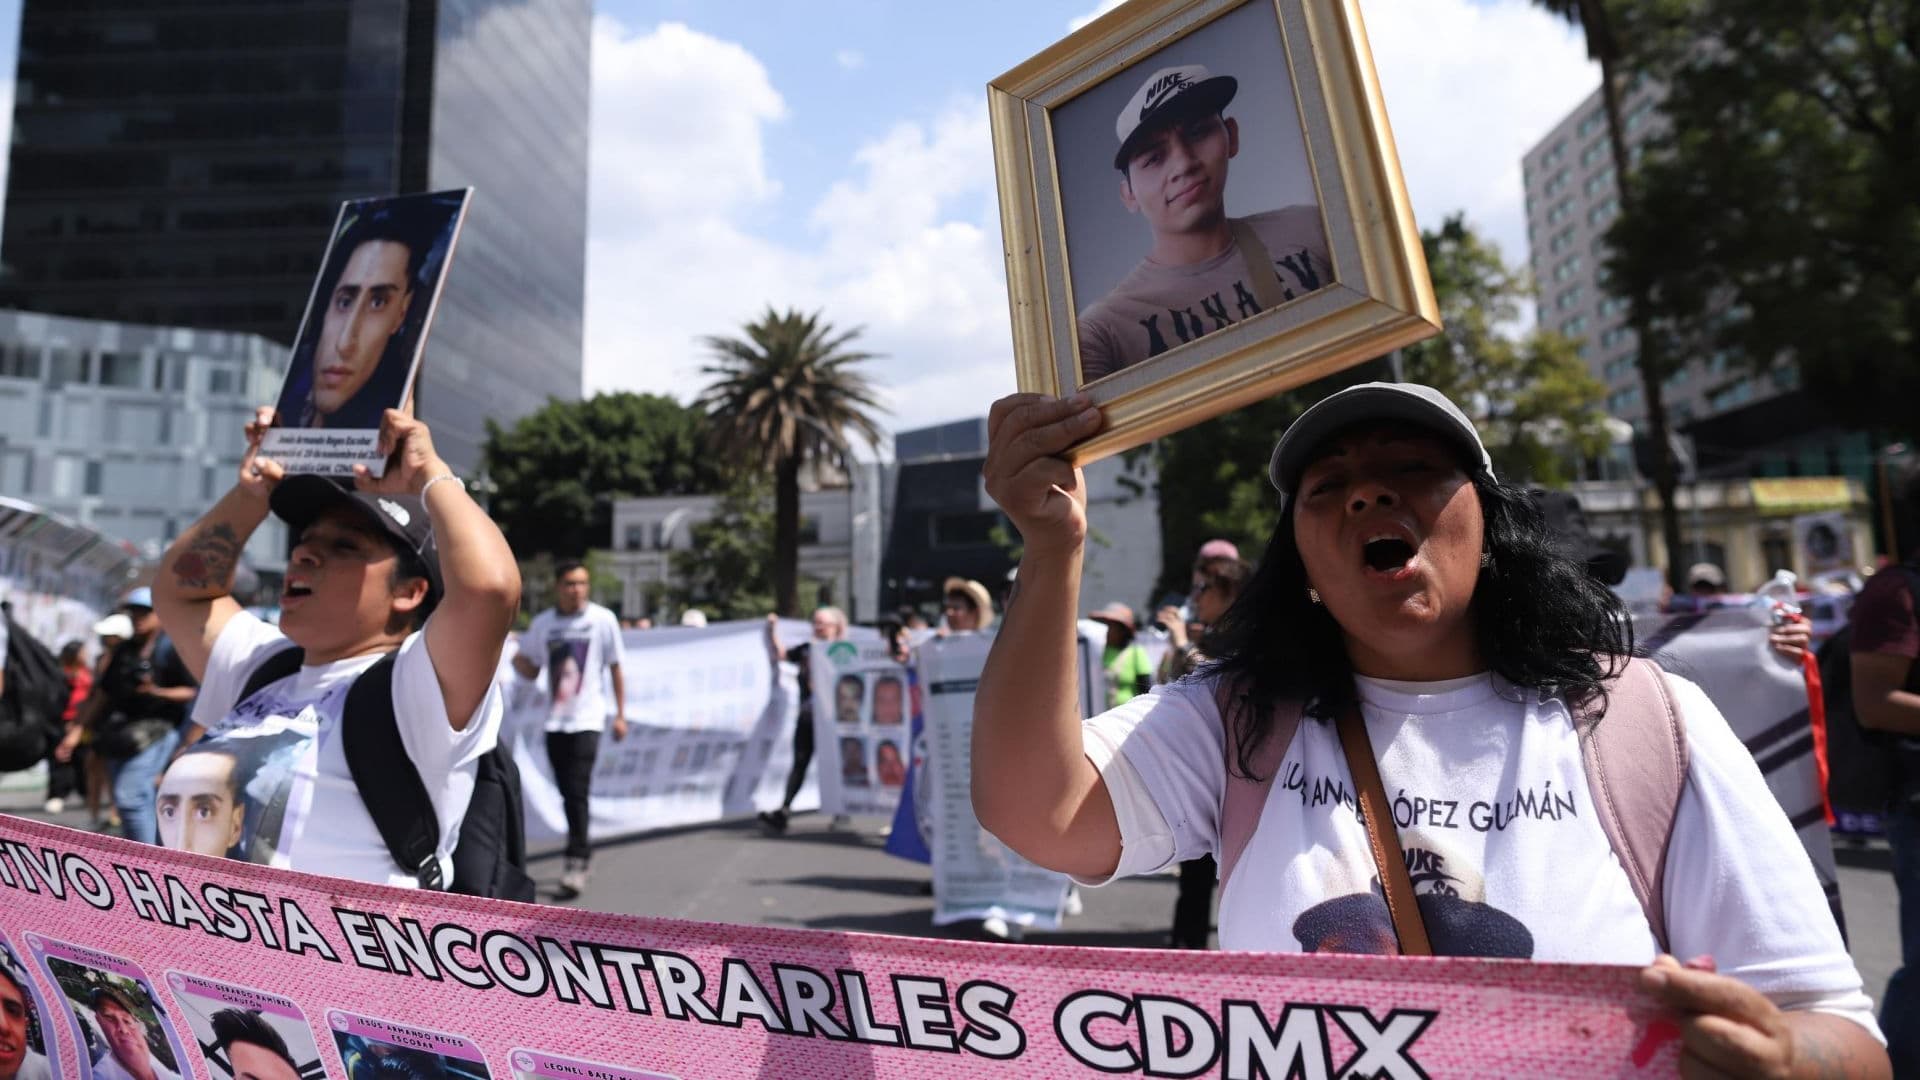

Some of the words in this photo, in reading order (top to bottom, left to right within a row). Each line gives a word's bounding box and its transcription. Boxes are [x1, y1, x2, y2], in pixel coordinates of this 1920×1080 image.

[1146, 72, 1182, 104] NIKE
[1393, 789, 1459, 829] ÓPEZ
[1402, 847, 1445, 872] IKE
[112, 864, 342, 963] HASTA
[331, 907, 1027, 1060] ENCONTRARLES
[1053, 988, 1440, 1080] CDMX
[387, 1025, 431, 1041] ARMANDO
[434, 1035, 464, 1048] REYES
[391, 1034, 434, 1050] ESCOBAR
[543, 1062, 584, 1076] LEONEL
